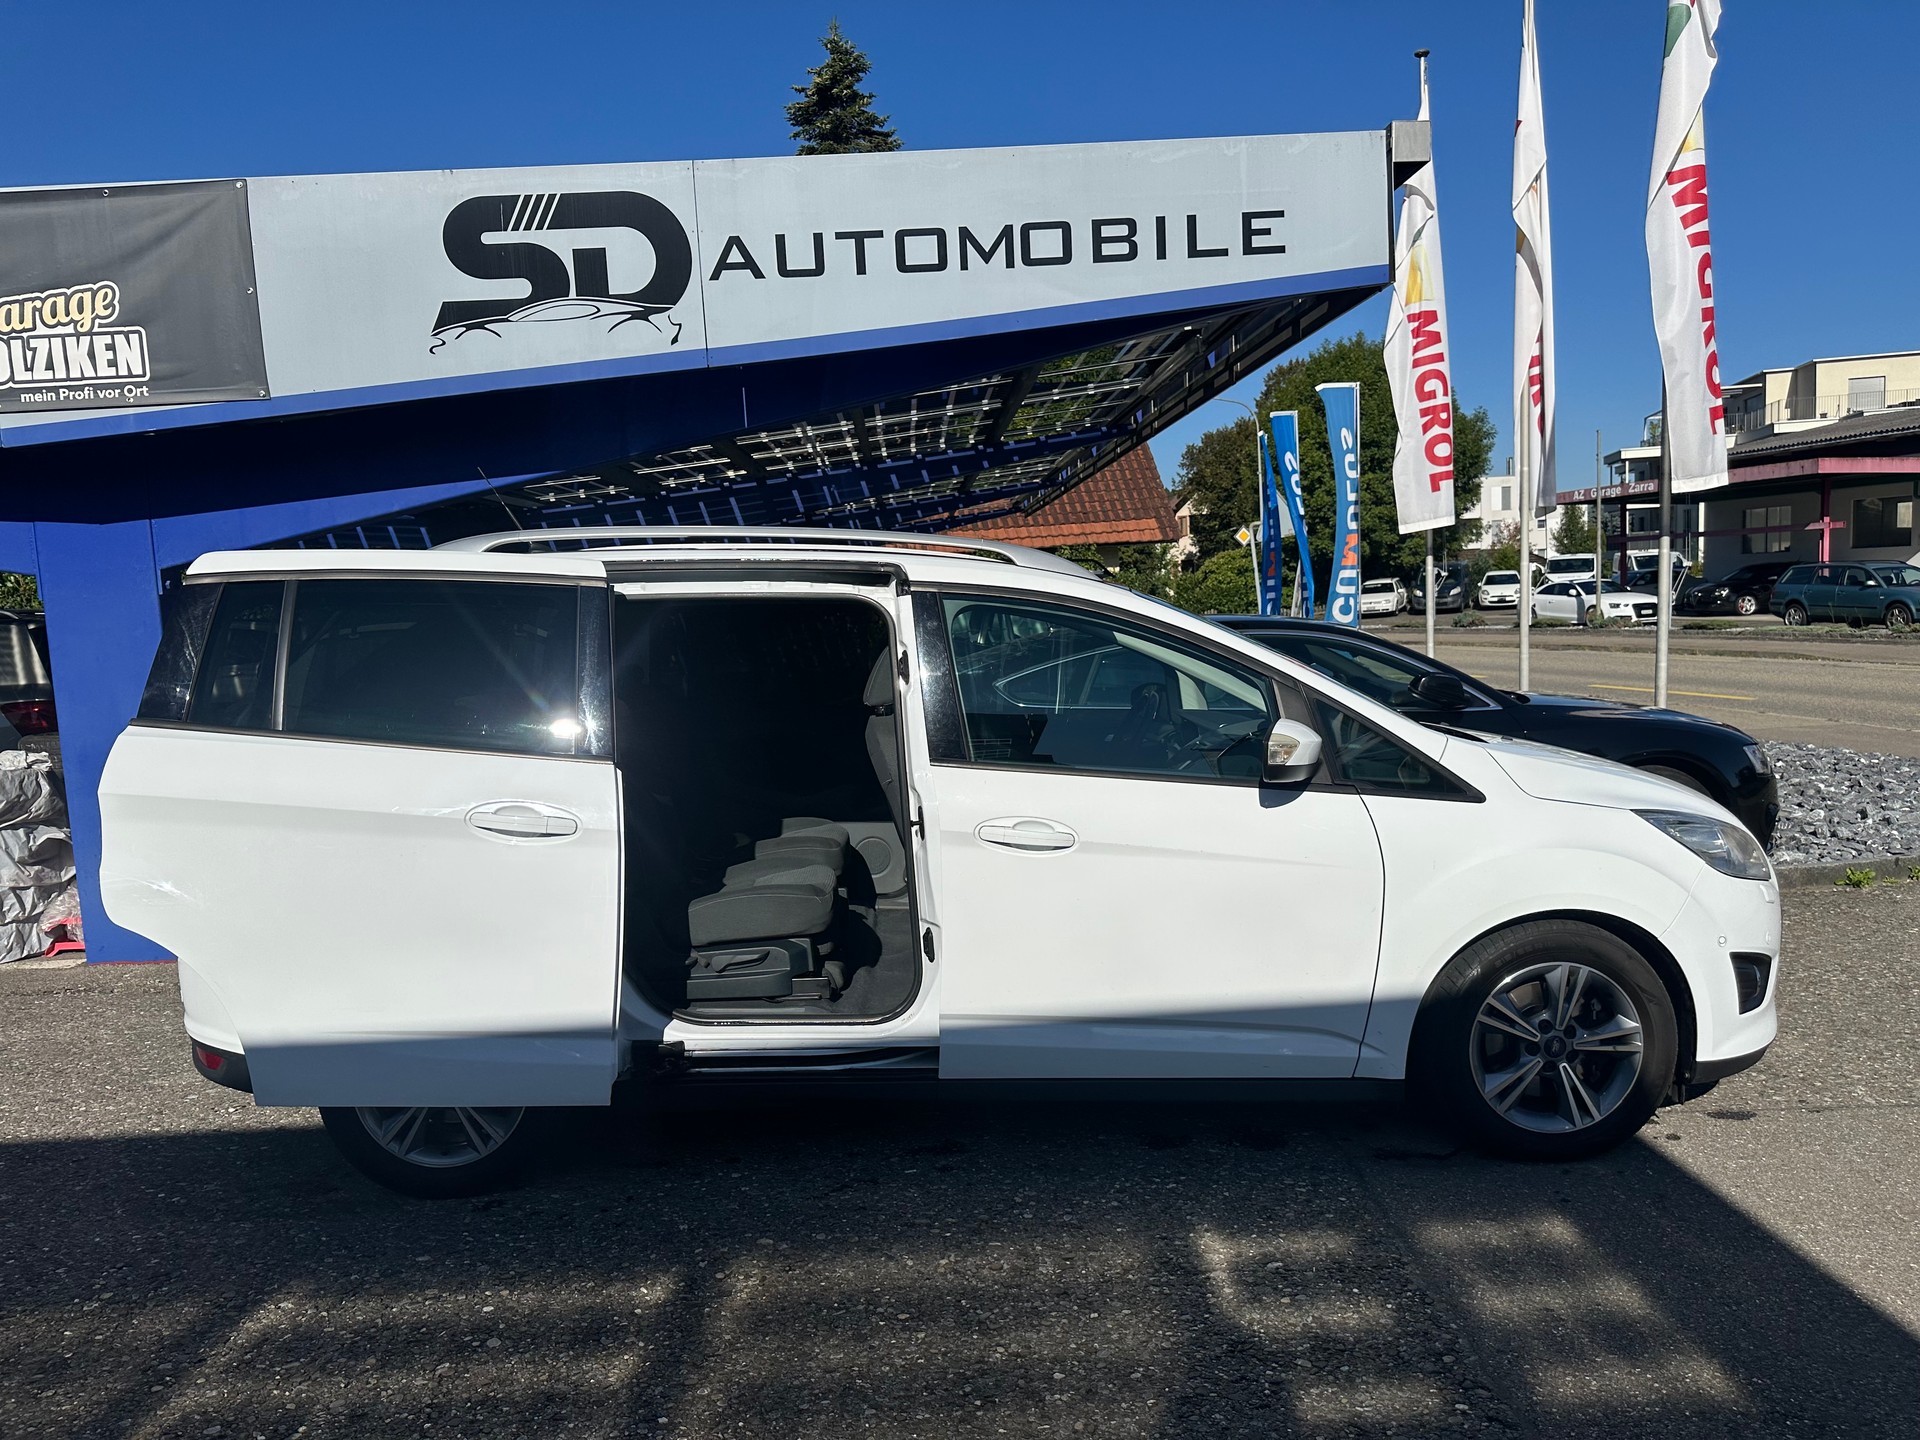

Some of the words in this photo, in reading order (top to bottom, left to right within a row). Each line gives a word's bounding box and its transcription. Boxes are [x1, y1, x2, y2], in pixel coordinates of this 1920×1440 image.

[709, 209, 1286, 281] AUTOMOBILE
[20, 388, 56, 403] mein
[59, 386, 94, 401] Profi
[97, 387, 121, 397] vor
[124, 384, 149, 398] Ort
[1407, 309, 1454, 493] MIGROL
[1573, 490, 1585, 500] AZ
[1590, 486, 1622, 498] Grage
[1628, 481, 1655, 493] Zarra
